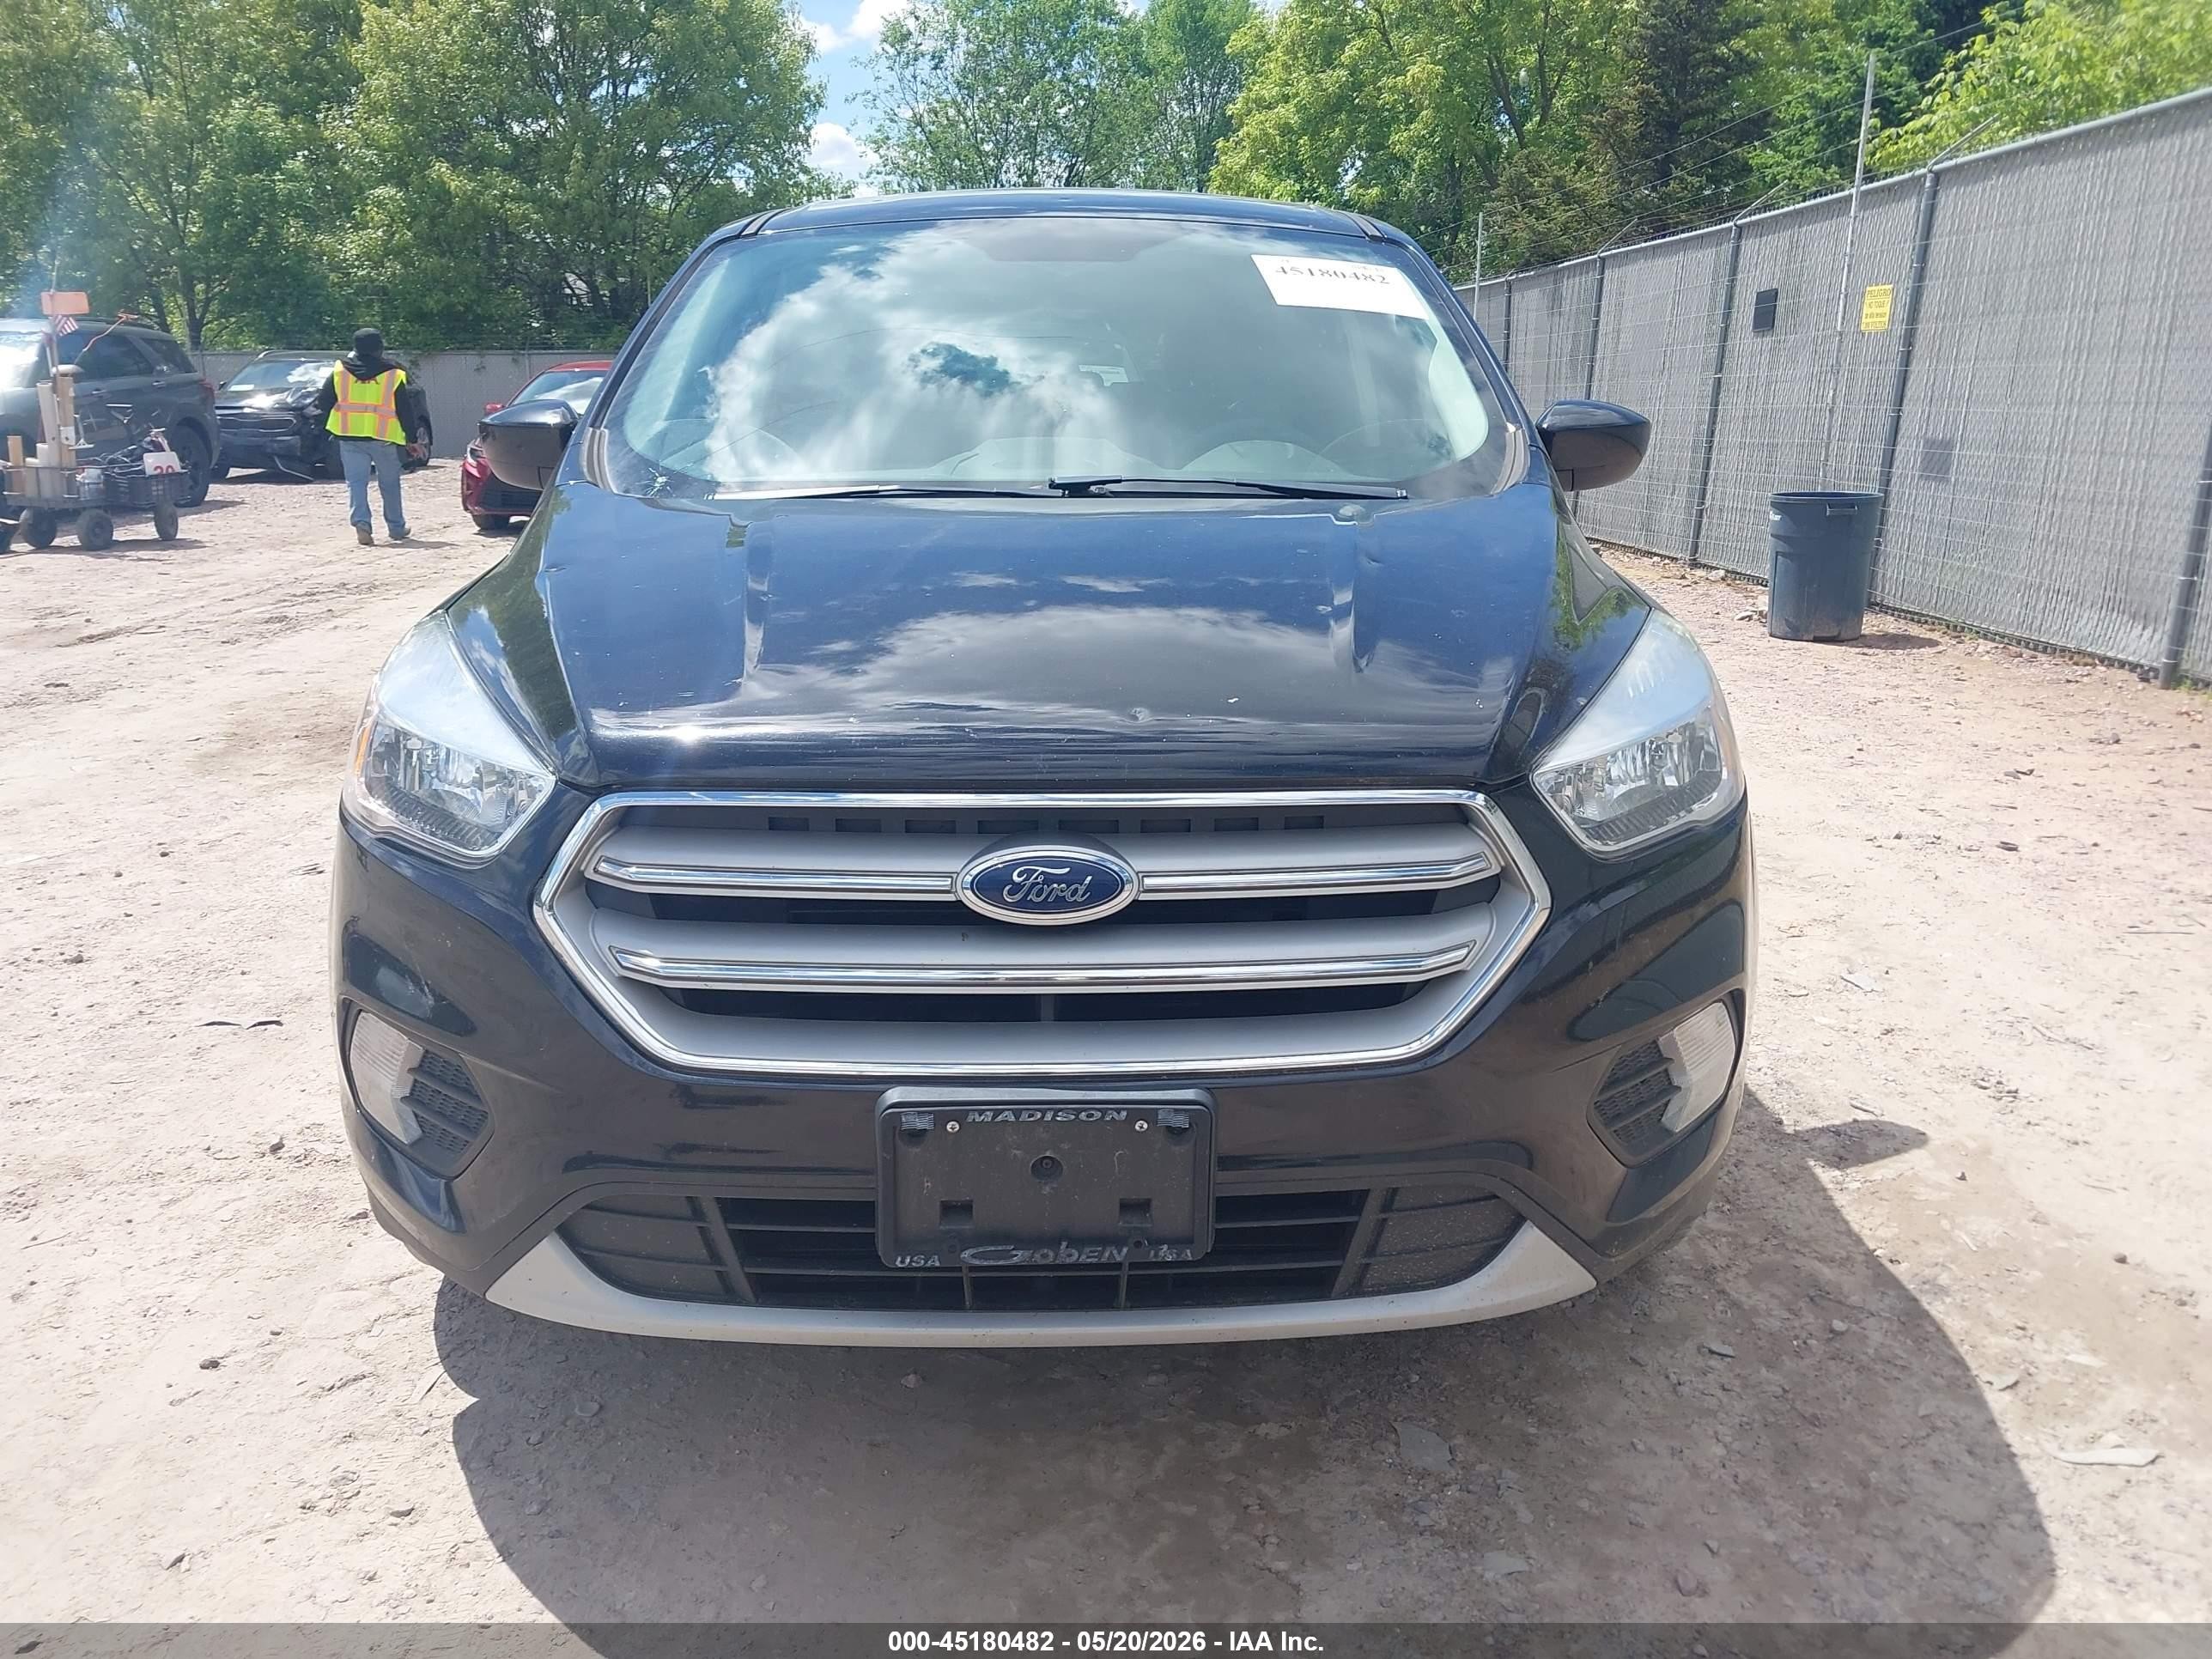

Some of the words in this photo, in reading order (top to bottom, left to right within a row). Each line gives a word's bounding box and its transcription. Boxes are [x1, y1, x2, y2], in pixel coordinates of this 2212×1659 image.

[1275, 265, 1391, 285] 45180482
[1867, 288, 1892, 298] PELIGRO
[1002, 866, 1093, 902] Ford
[966, 1109, 1127, 1122] MADISON
[895, 1255, 941, 1267] USA
